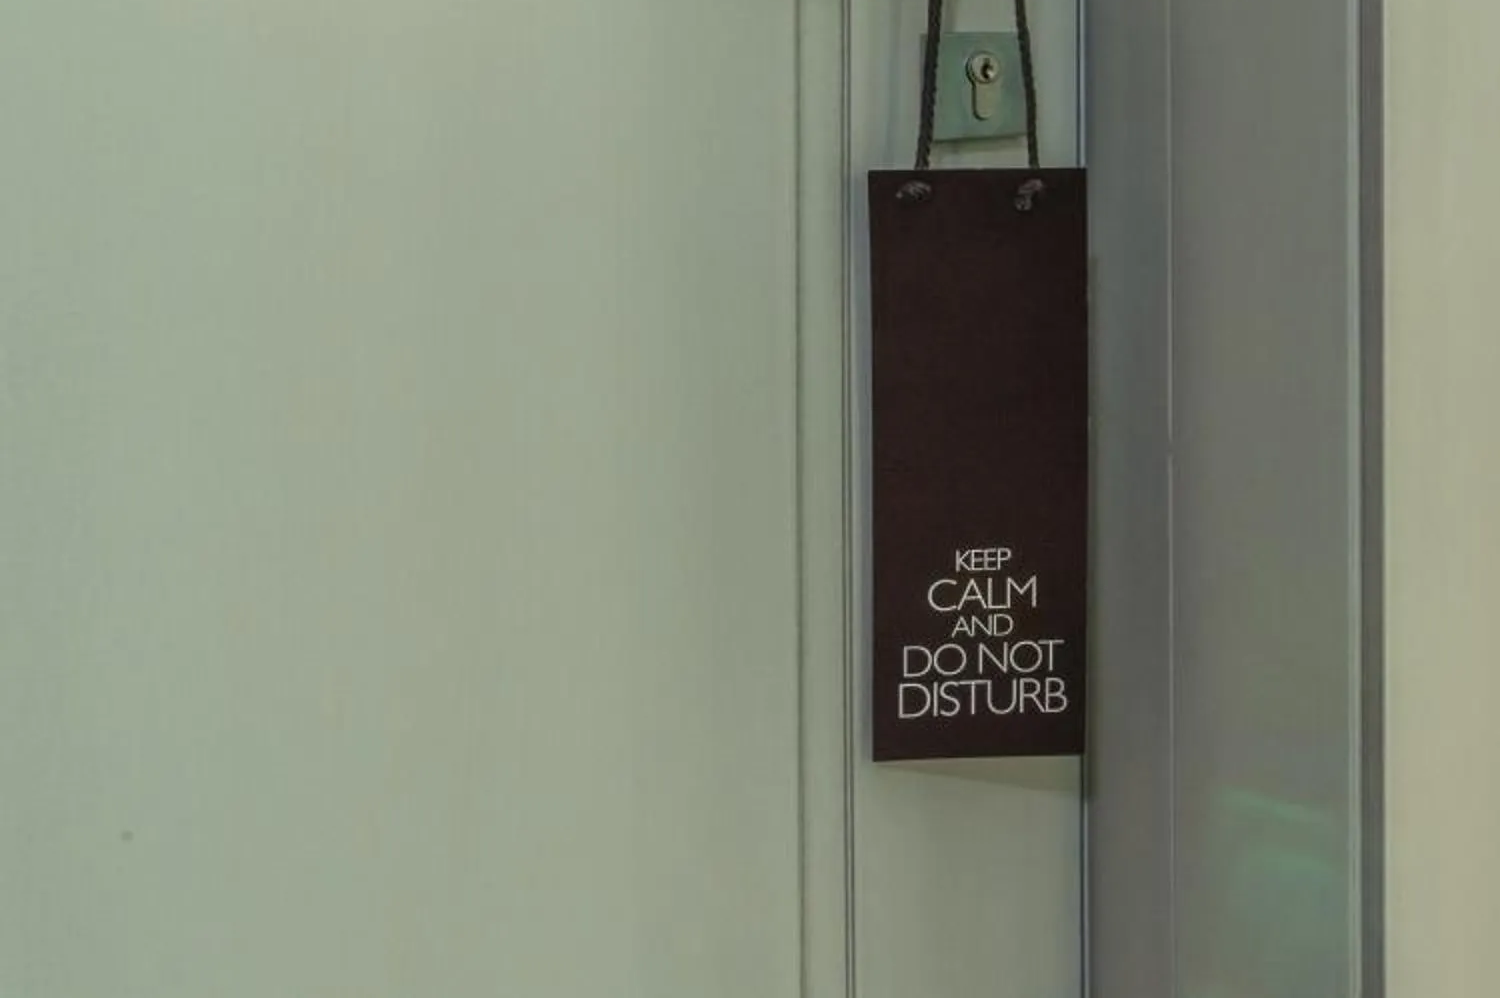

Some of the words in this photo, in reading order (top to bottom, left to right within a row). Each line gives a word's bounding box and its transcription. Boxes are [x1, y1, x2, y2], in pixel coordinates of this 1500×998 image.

[955, 547, 1012, 572] KEEP
[927, 575, 1037, 611] CALM
[951, 613, 1014, 638] AND
[903, 643, 967, 678] DO
[979, 639, 1065, 674] NOT
[898, 677, 1068, 719] DISTURB
